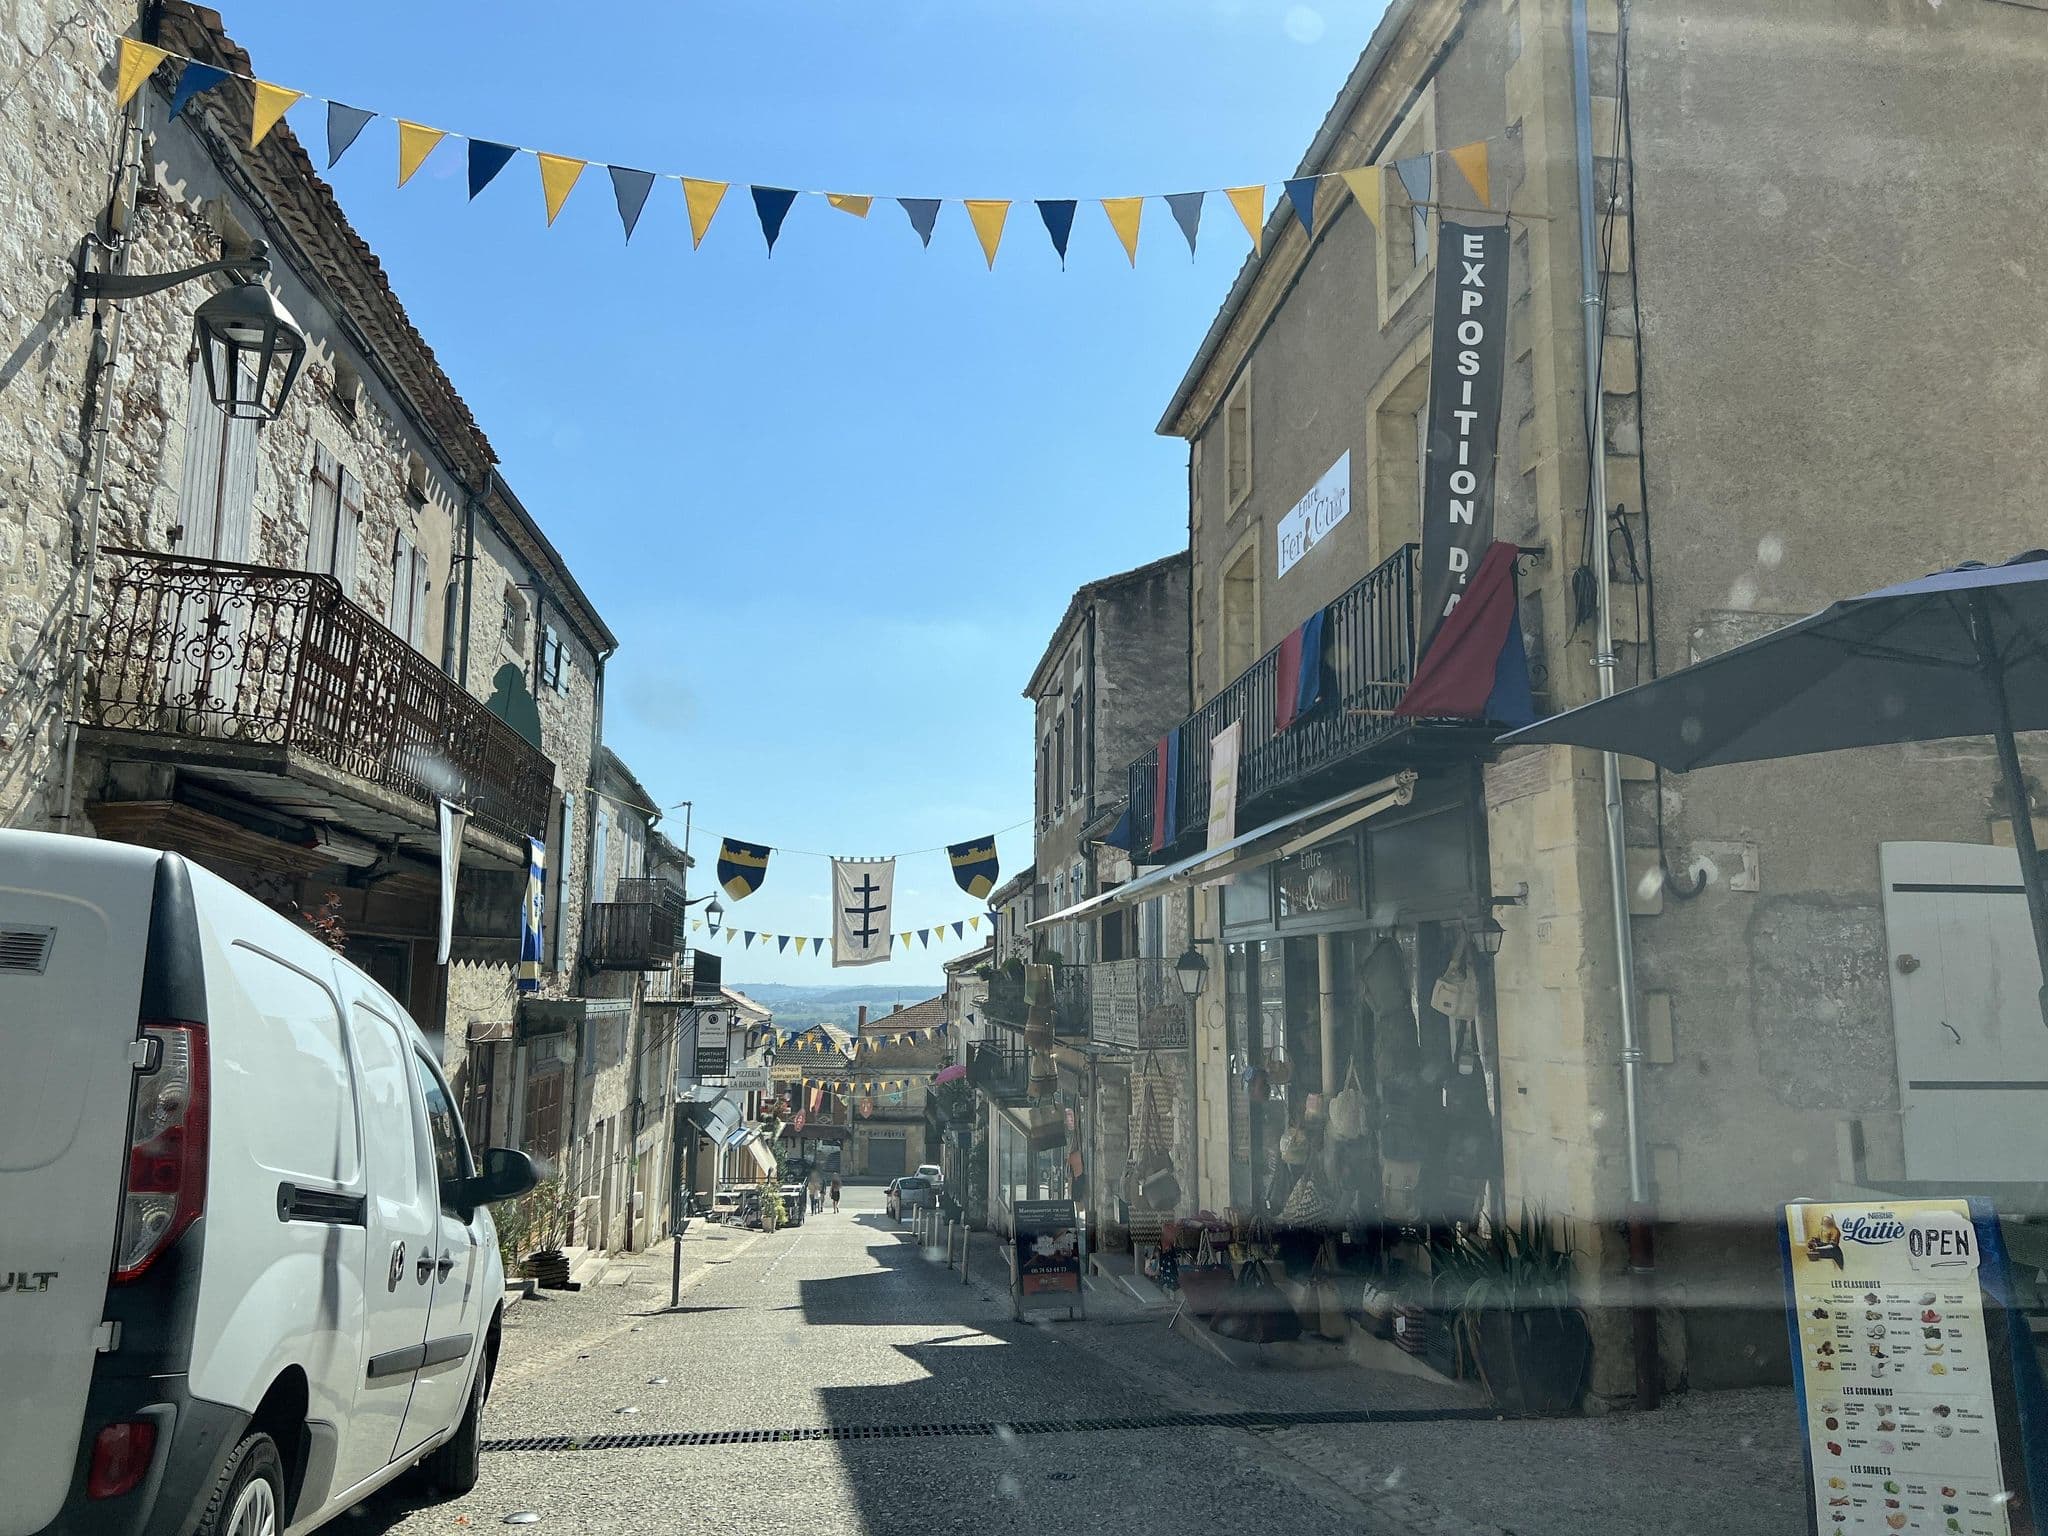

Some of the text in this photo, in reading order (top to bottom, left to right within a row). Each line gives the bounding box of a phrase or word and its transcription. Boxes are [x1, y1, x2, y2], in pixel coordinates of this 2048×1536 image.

[1449, 233, 1485, 525] EXPOSITION
[1299, 850, 1322, 870] Entre
[1306, 875, 1319, 912] &
[1909, 1228, 1970, 1257] OPEN
[1831, 1280, 1881, 1289] LES CLASSIQUES
[1842, 1386, 1893, 1397] LES GOURMANDS
[1850, 1465, 1892, 1476] LES SORBETS
